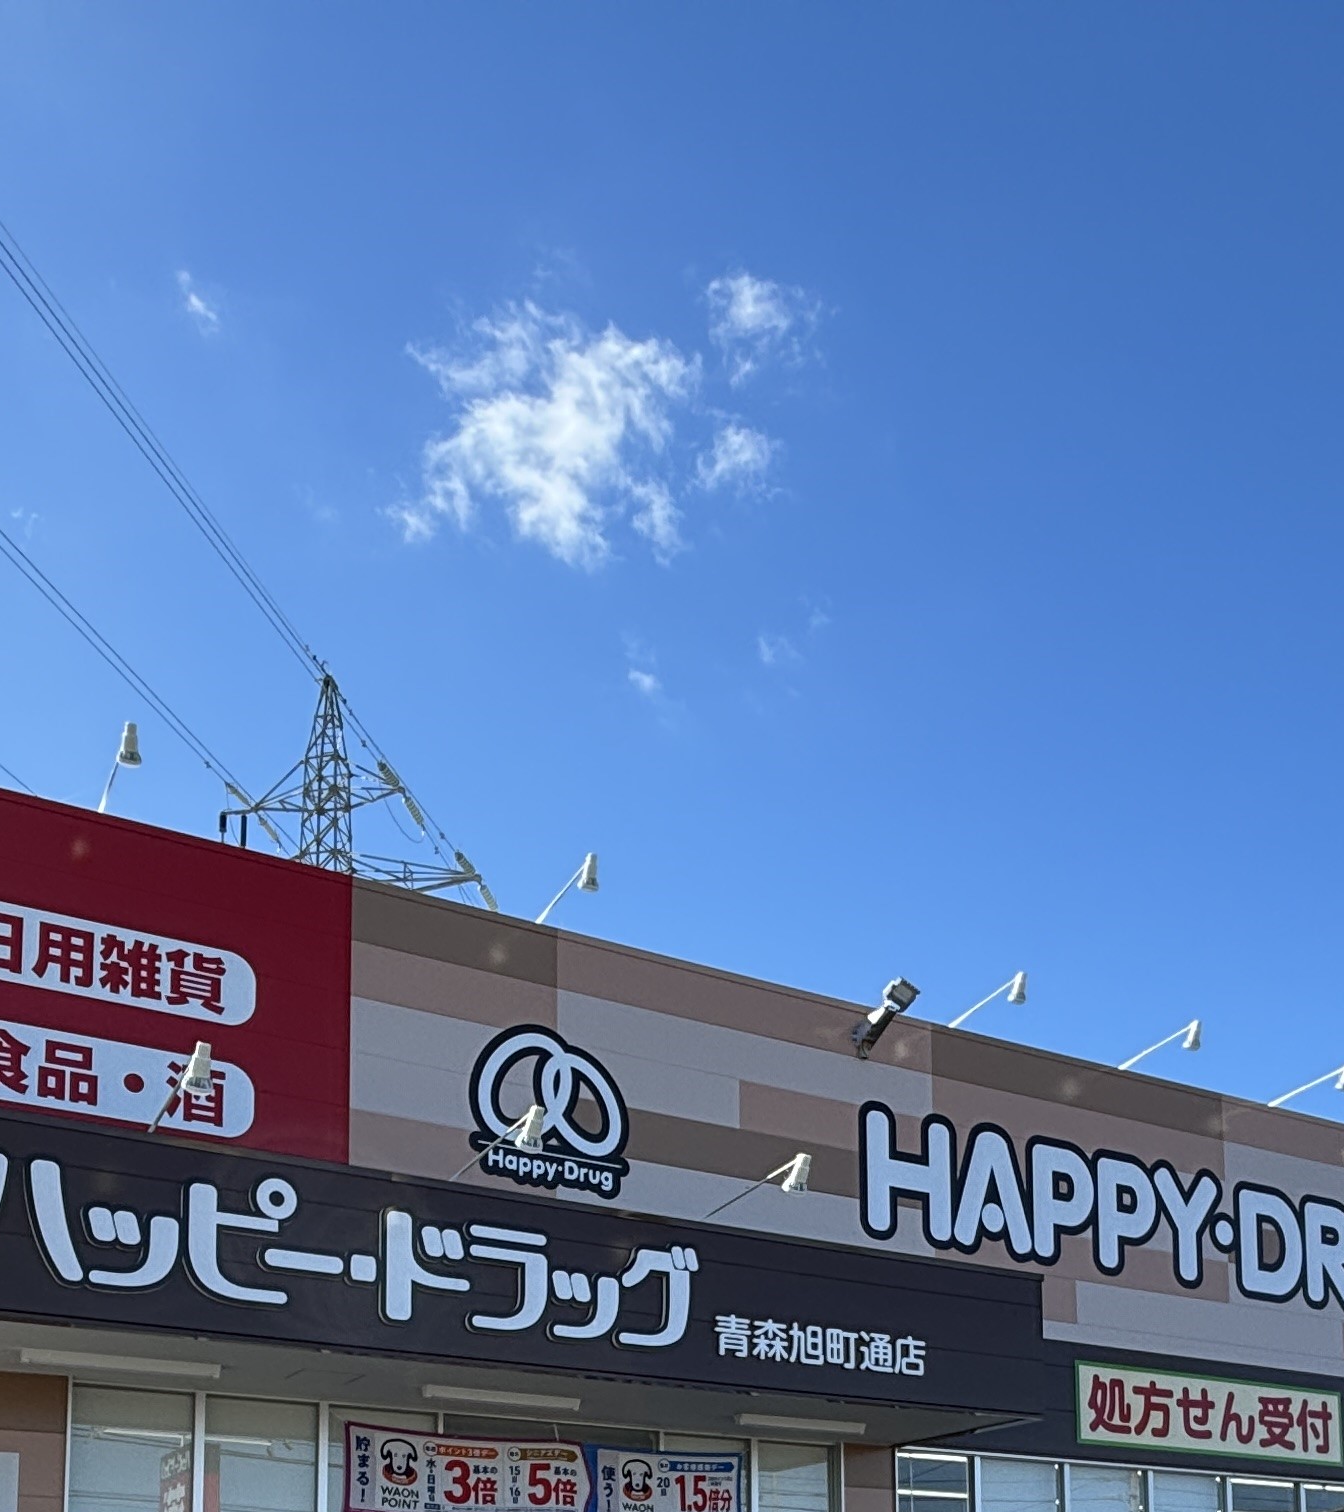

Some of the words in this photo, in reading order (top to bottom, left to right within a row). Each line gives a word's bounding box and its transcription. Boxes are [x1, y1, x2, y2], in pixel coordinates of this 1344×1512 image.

[714, 1314, 927, 1377] 青森旭町通店
[1088, 1371, 1332, 1455] 処方せん受付
[380, 1485, 420, 1500] WAON
[381, 1497, 420, 1511] POINT
[622, 1502, 654, 1512] WAON
